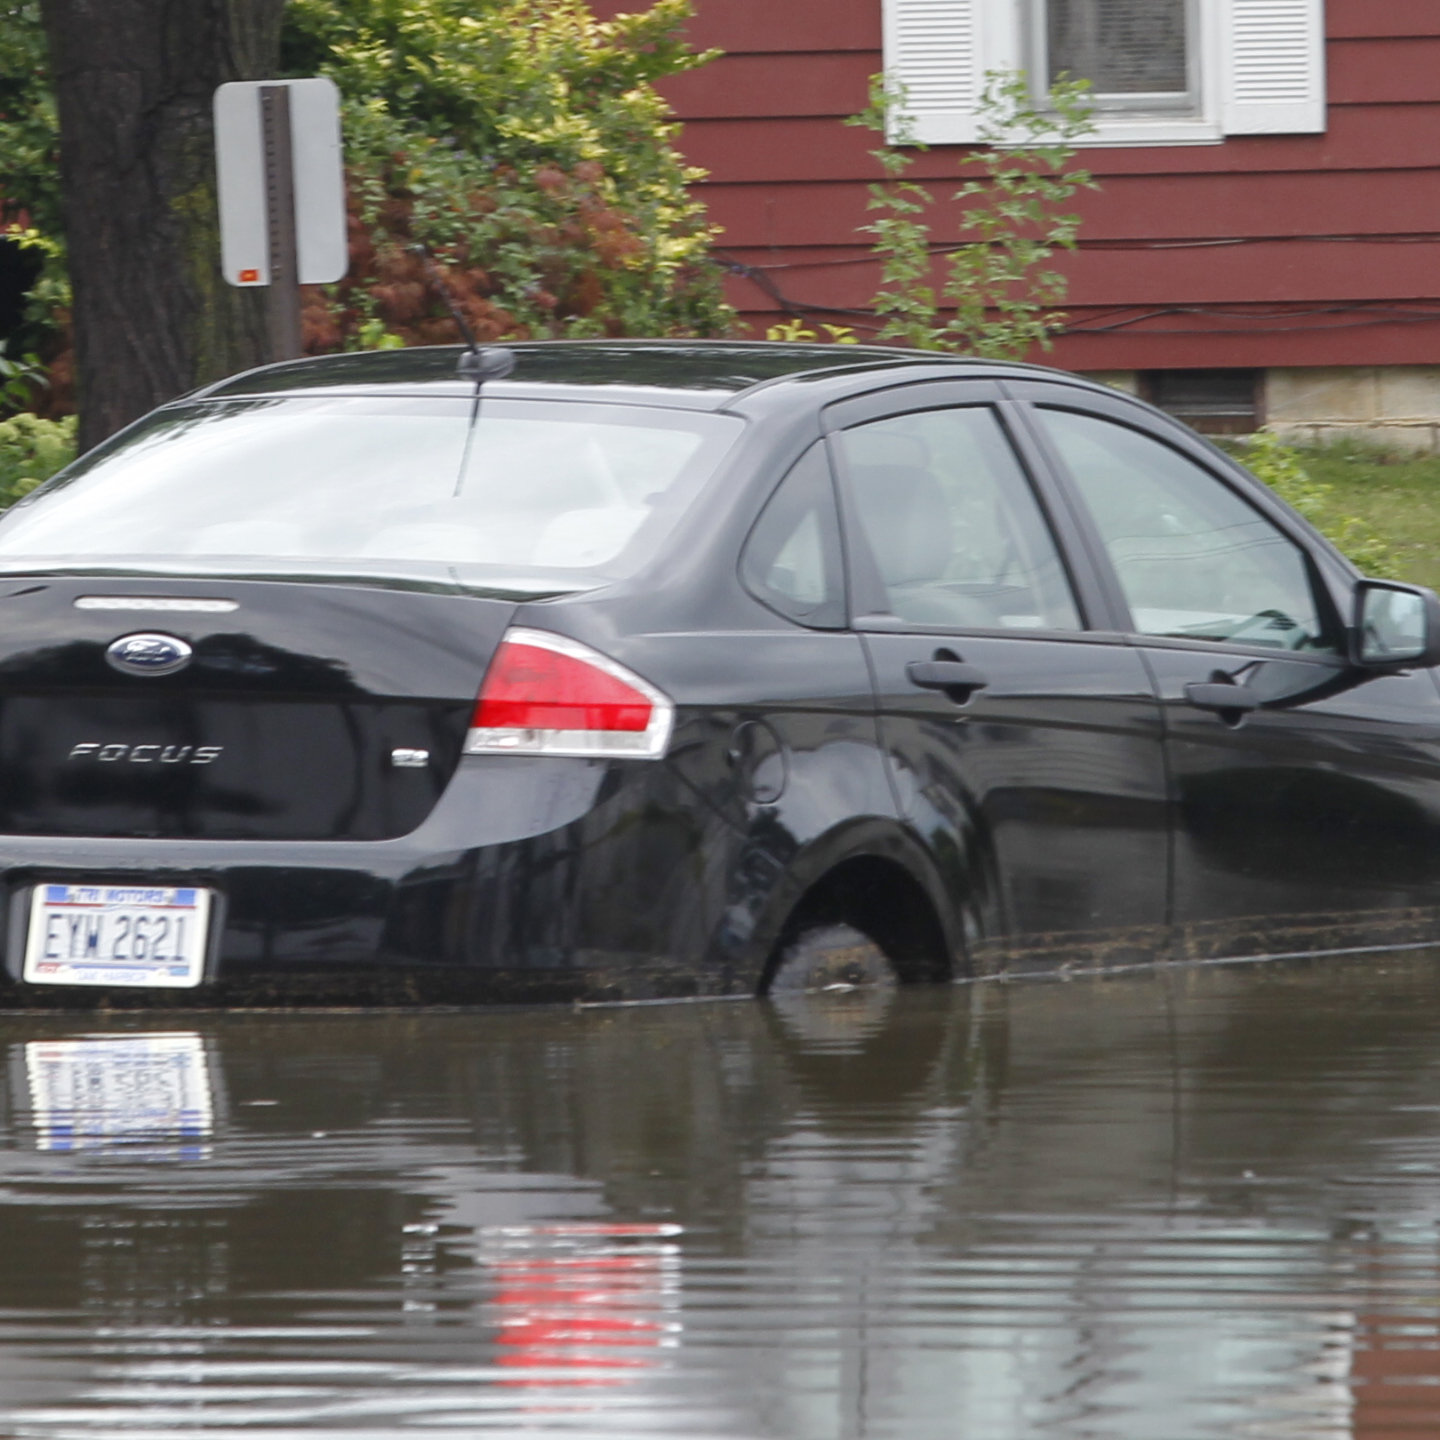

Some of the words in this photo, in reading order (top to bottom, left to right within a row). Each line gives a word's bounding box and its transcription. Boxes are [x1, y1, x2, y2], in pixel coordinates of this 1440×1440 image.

[68, 743, 224, 764] FOCUS
[45, 913, 104, 959] EYW
[113, 915, 187, 961] 2621
